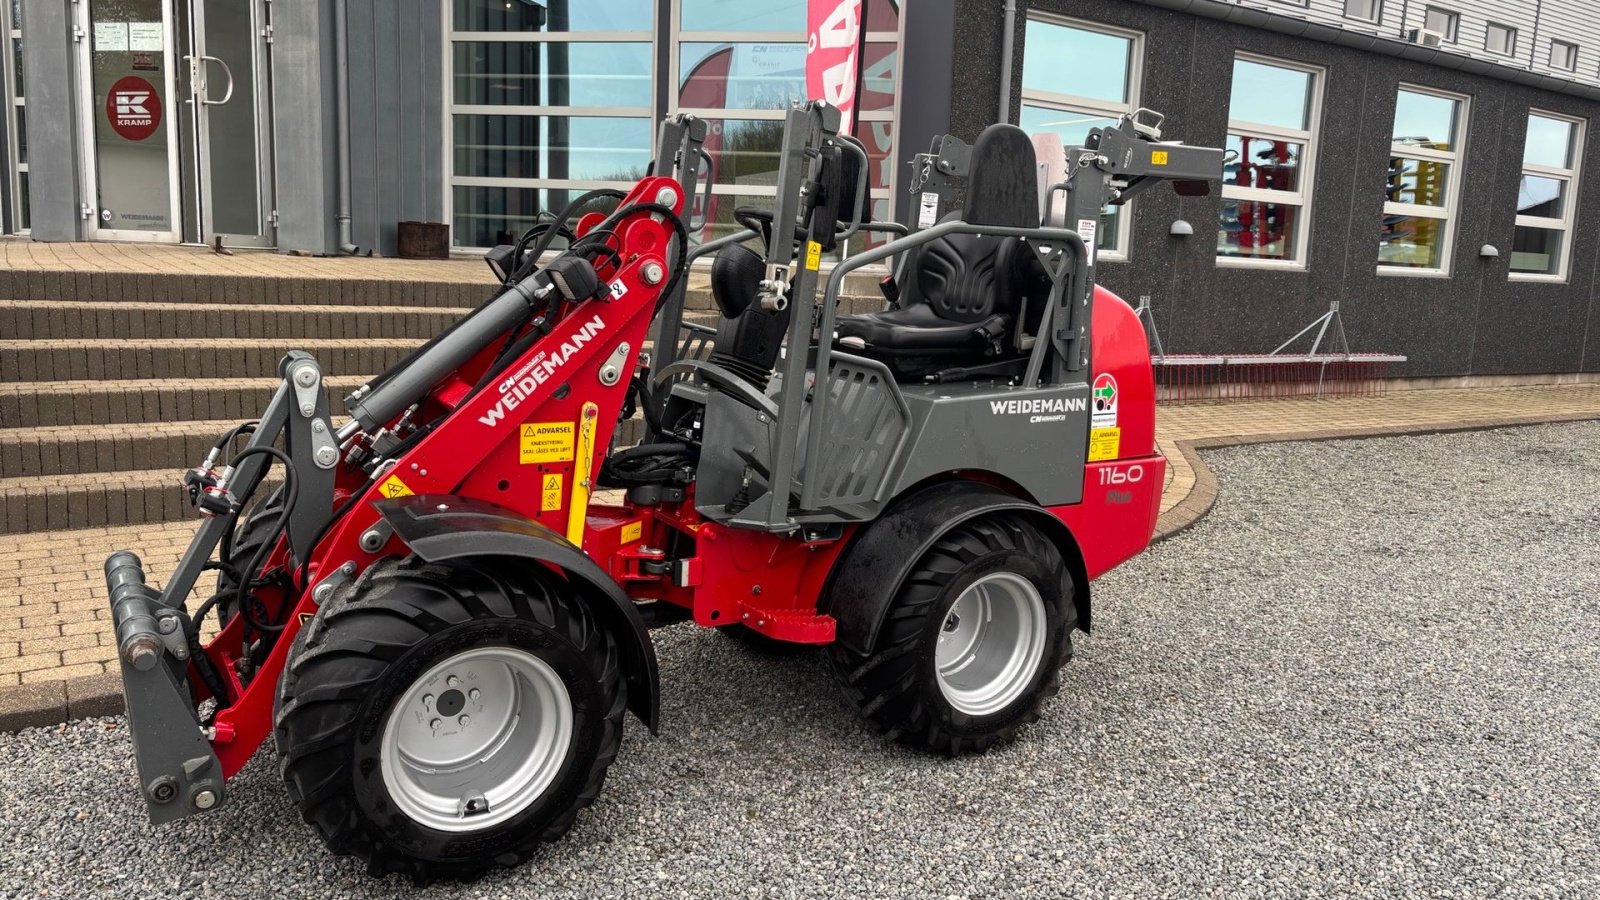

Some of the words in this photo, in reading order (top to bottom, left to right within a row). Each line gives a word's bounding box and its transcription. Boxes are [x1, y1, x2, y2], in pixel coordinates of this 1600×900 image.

[477, 314, 606, 427] WEIDEMANN
[990, 398, 1087, 415] WEIDEMANN
[537, 426, 571, 434] ADVARSEL
[1099, 465, 1143, 485] 1160
